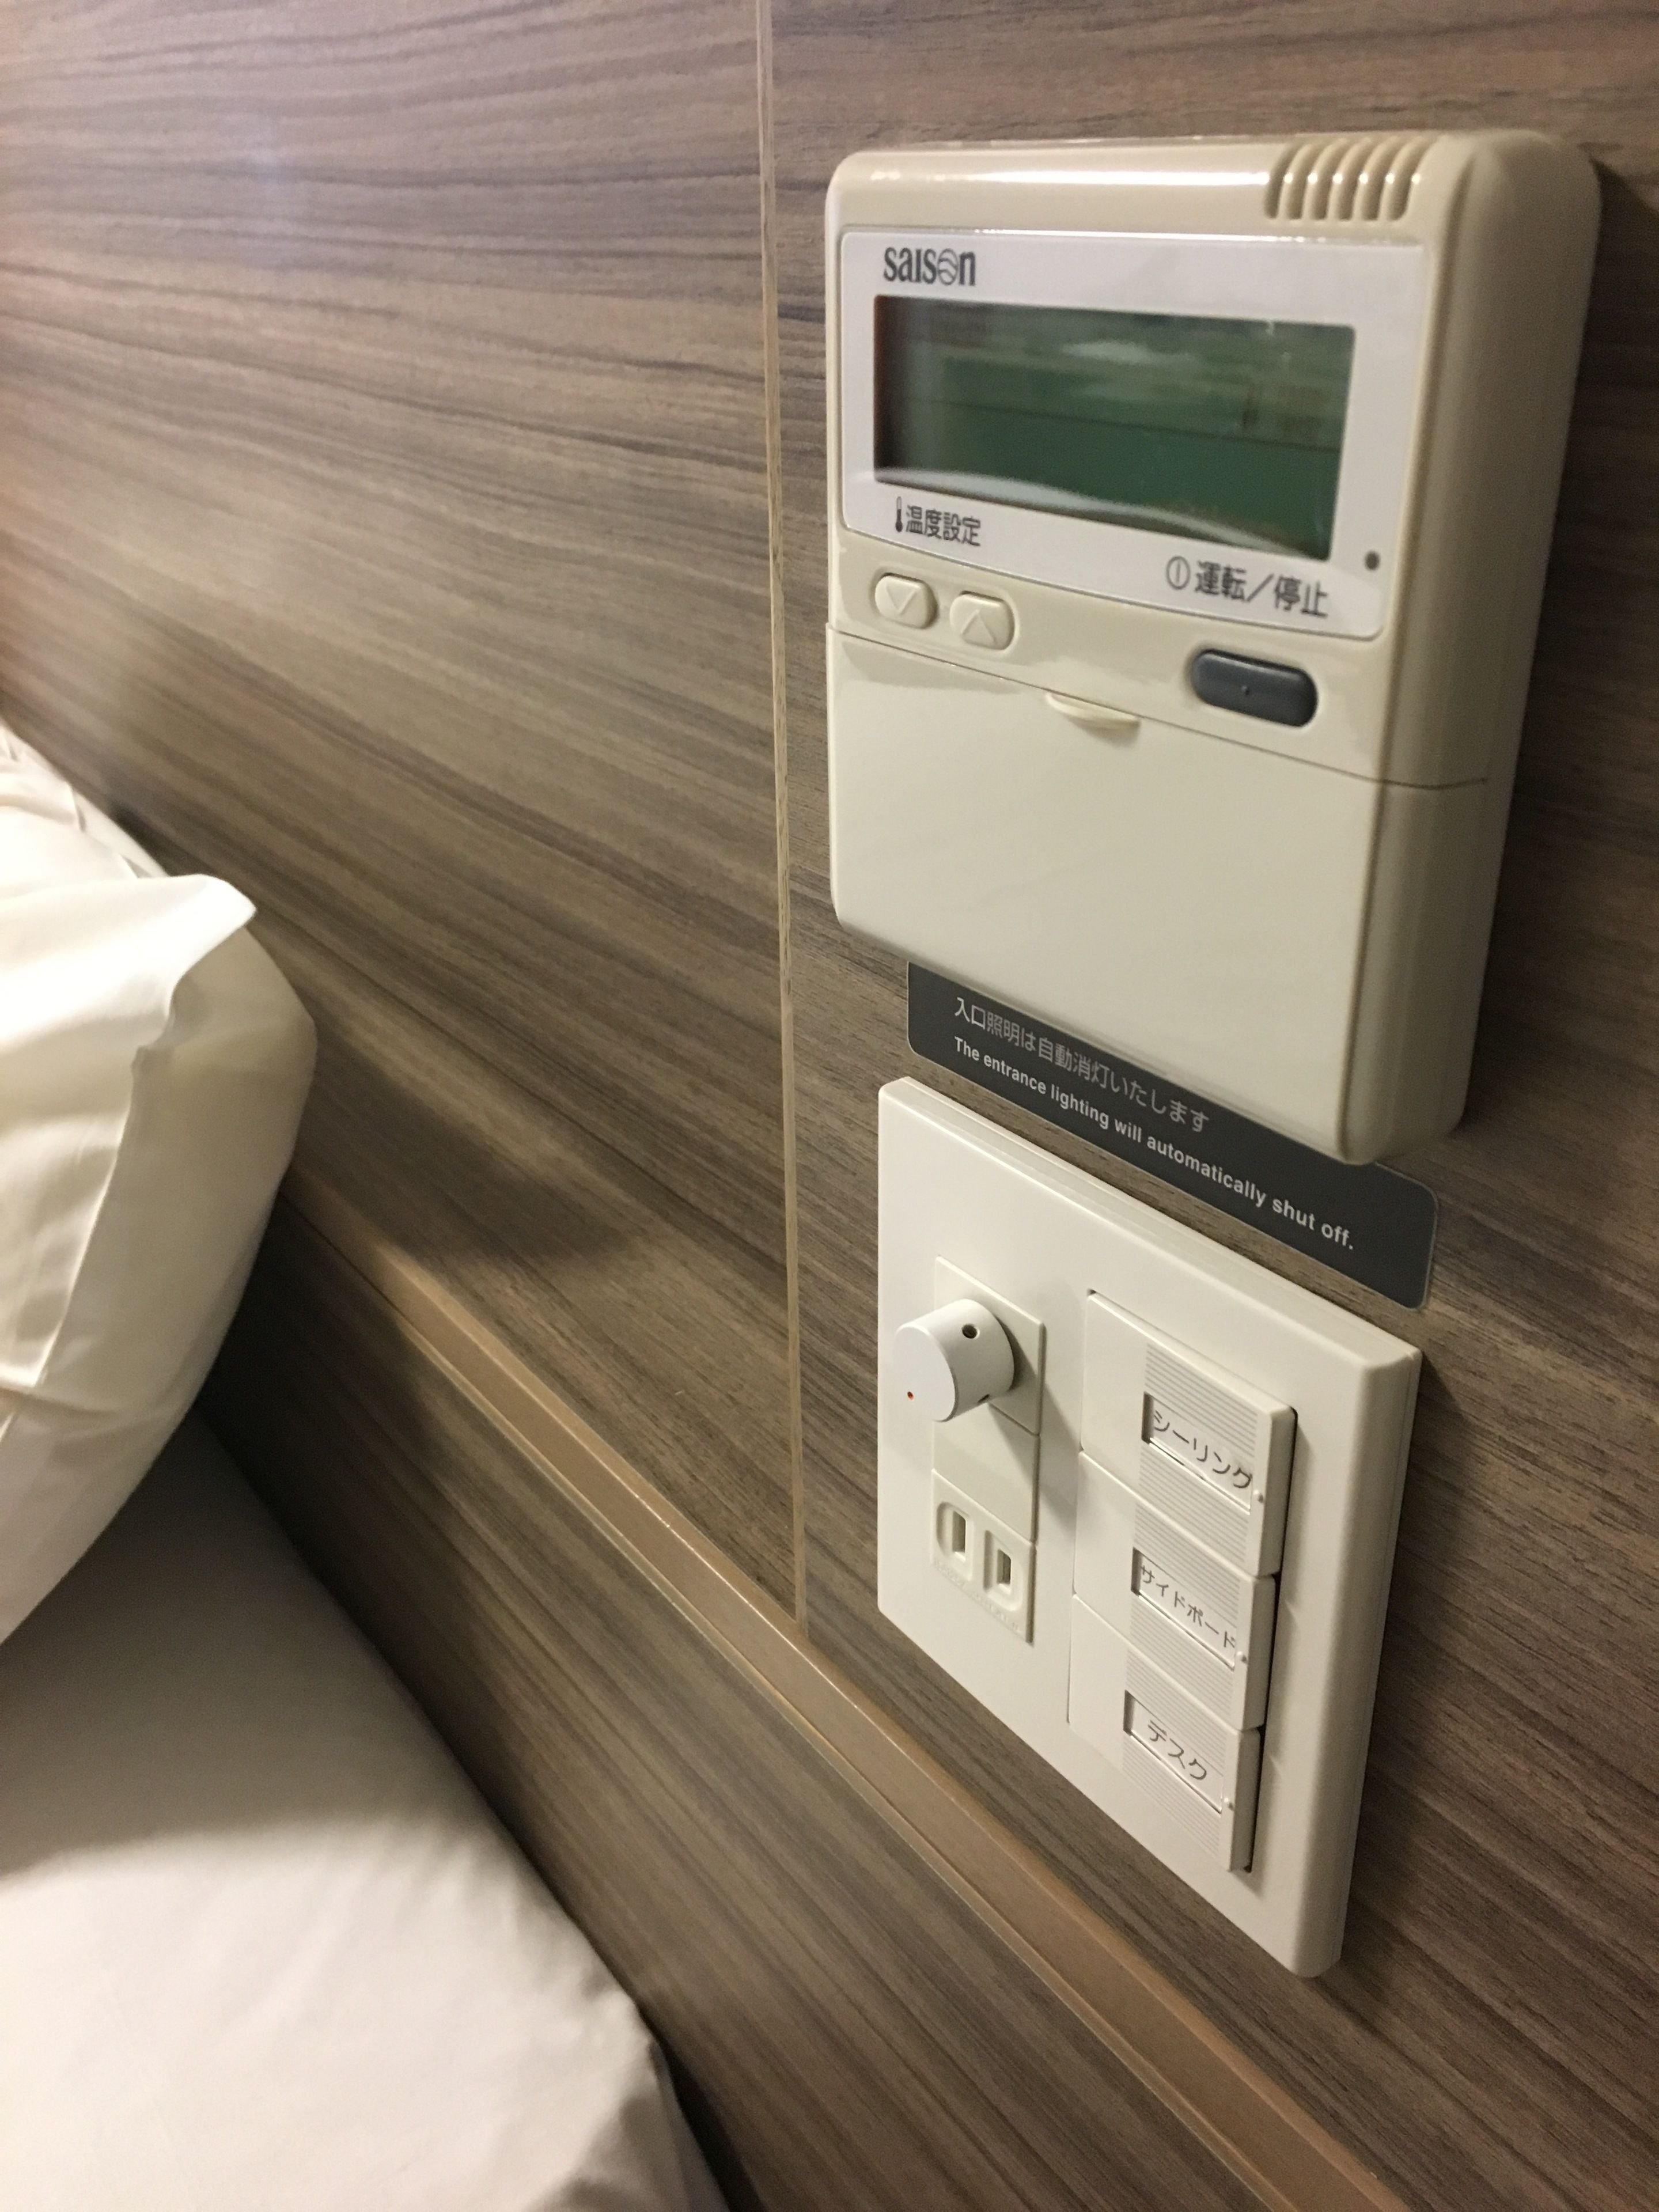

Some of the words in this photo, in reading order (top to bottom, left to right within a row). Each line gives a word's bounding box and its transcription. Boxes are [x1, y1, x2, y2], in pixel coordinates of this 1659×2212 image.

[883, 247, 976, 286] saison
[906, 504, 980, 547] 温度設定
[955, 997, 1209, 1132] 入口照明は自動消灯いたします
[955, 1036, 980, 1060] The
[984, 1054, 1046, 1094] entrance
[1051, 1084, 1109, 1129] lighting
[1114, 1119, 1142, 1143] will
[1147, 1136, 1266, 1207] automatically
[1272, 1198, 1315, 1230] shut
[1321, 1223, 1354, 1250] off.
[1141, 1565, 1235, 1648] サイドボード
[1147, 1719, 1207, 1780] デスク
